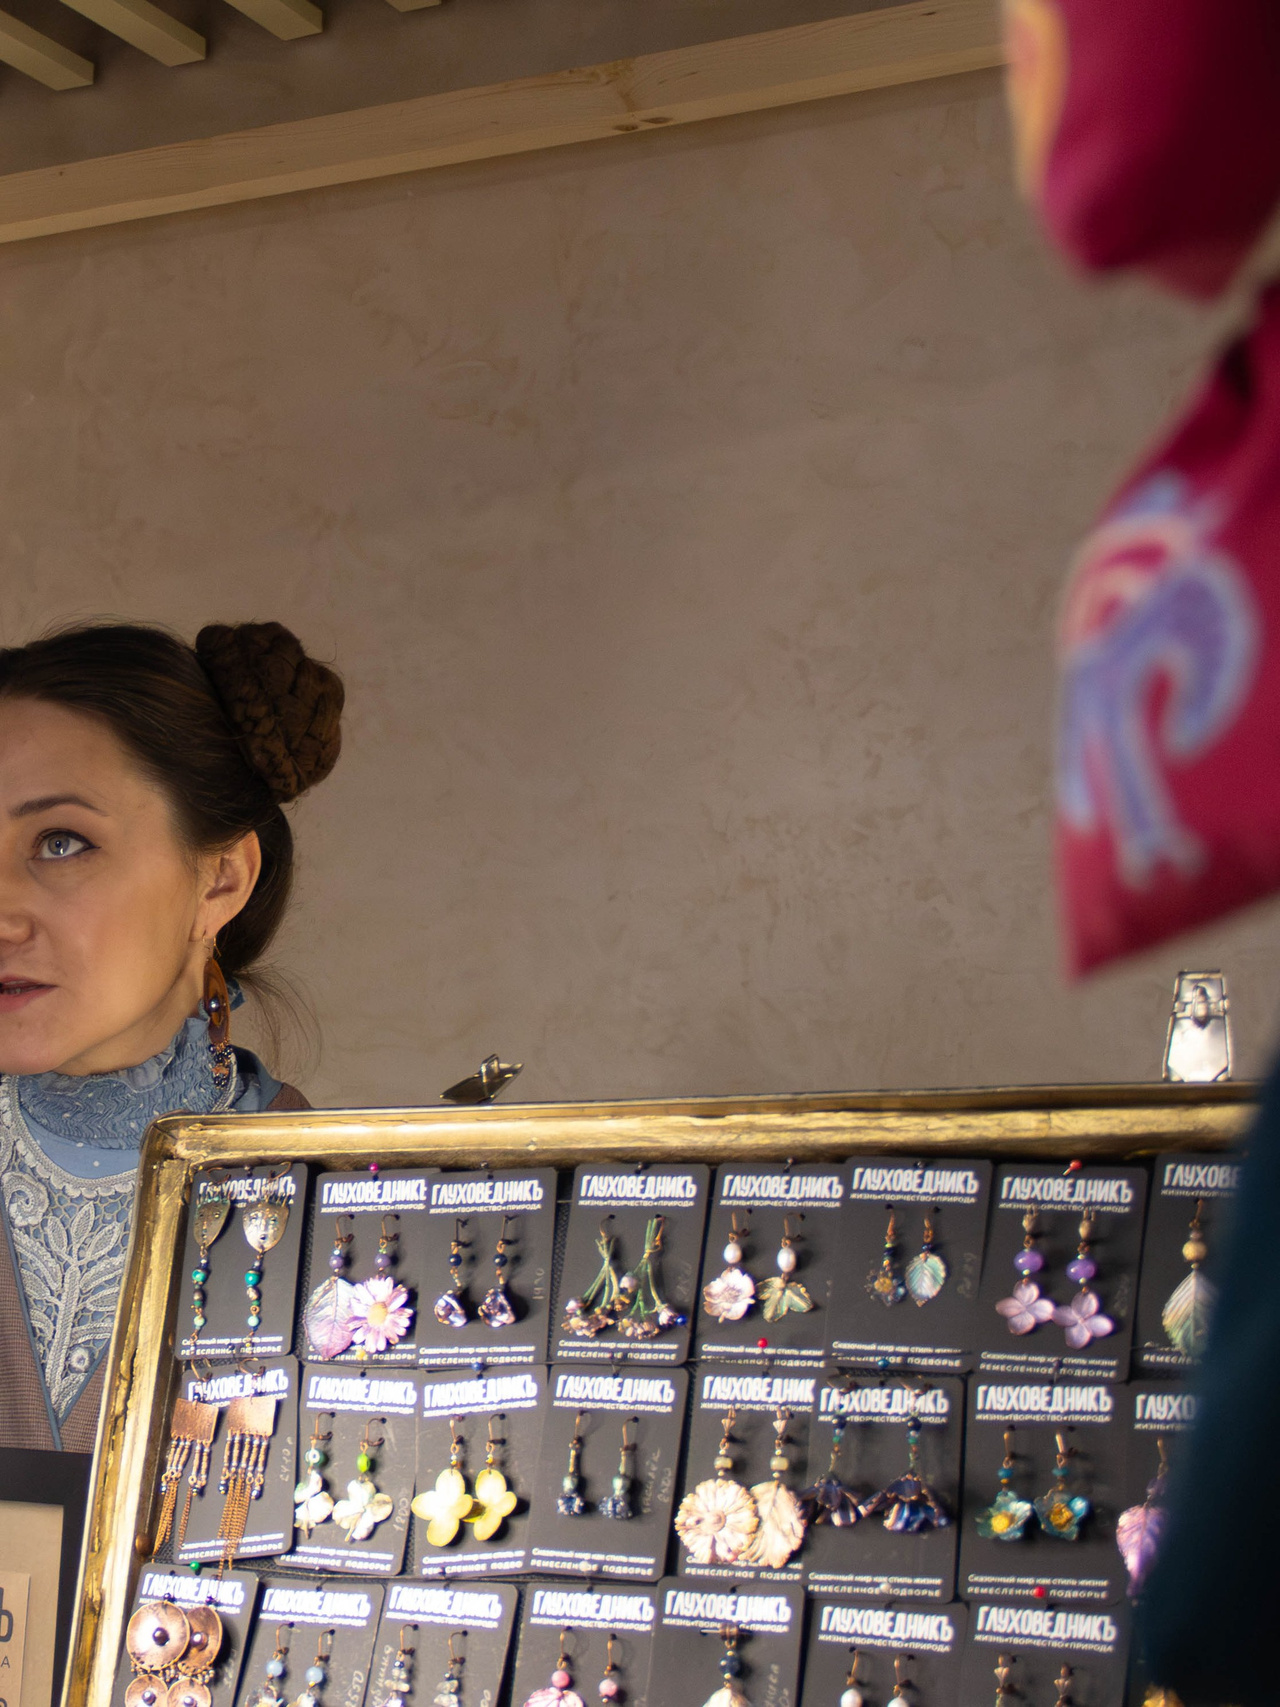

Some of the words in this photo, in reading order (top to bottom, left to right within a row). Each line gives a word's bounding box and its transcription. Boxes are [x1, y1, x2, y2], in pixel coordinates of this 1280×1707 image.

[431, 1179, 544, 1205] ГЛУХОВЕДНИКЪ
[581, 1175, 698, 1200] ГЛУХОВЕДНИКЪ
[722, 1174, 844, 1199] ГЛУХОВЕДНИКЪ
[852, 1167, 980, 1194] ГЛУХОВЕДНИКЪ
[1001, 1176, 1133, 1203] ГЛУХОВЕДНИКЪ
[980, 1363, 1054, 1374] РЕМЕСЛЕННОЕ
[1060, 1367, 1117, 1378] ПОДВОРЬЕ
[556, 1375, 675, 1403] ГЛУХОВЕДНИКЪ
[703, 1376, 817, 1403] ГЛУХОВЕДНИК
[977, 1385, 1113, 1413] ГЛУХОВЕДНИКЪ
[808, 1584, 880, 1594] РЕМЕСЛЕННОЕ
[1050, 1589, 1108, 1598] ПОДВОРЬЕ
[533, 1590, 654, 1622] ГЛУХОВЕДНИКЪ
[664, 1590, 792, 1622] ГЛУХОВЕДНИКЪ
[821, 1606, 955, 1642] ГЛУХОВЕДНИКЪ
[977, 1606, 1117, 1642] ГЛУХОВЕДНИКЪ
